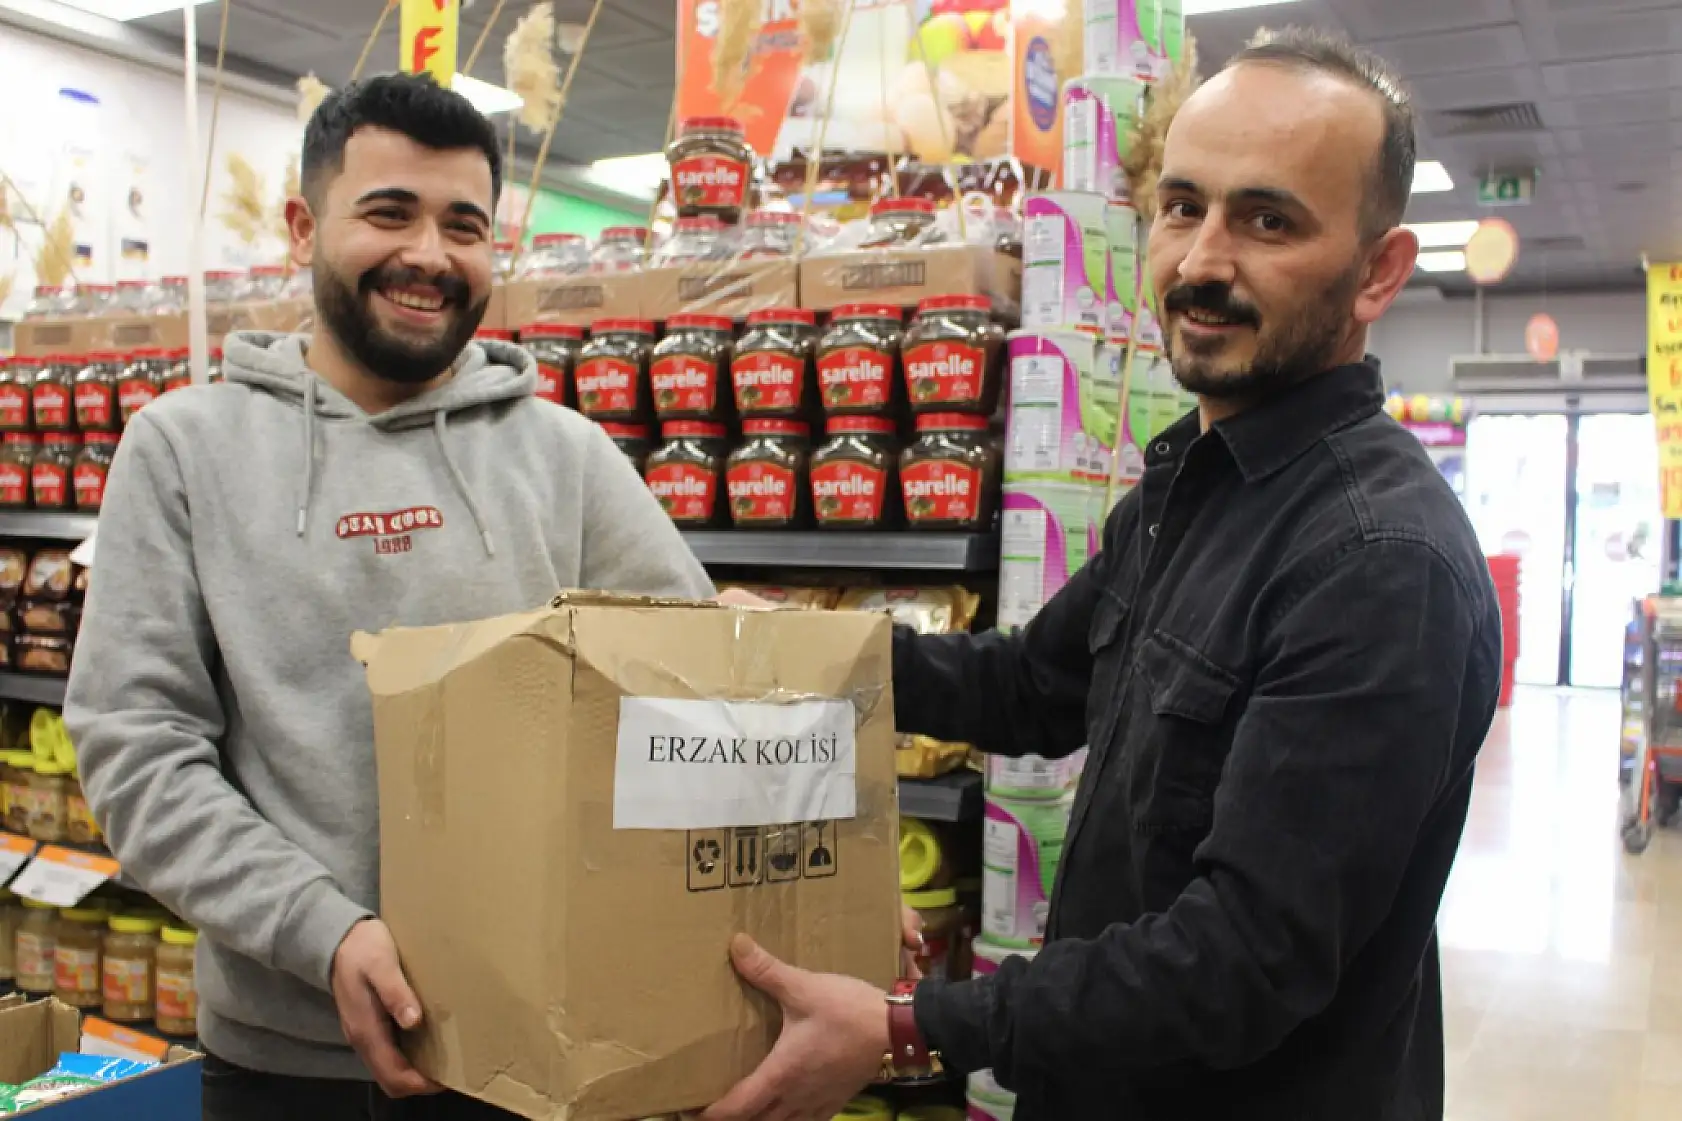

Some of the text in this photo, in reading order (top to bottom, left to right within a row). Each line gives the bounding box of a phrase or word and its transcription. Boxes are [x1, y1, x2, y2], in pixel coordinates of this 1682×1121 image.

[734, 364, 794, 386] sarelle
[821, 359, 884, 385] sarelle
[908, 354, 974, 379] sarelle
[576, 369, 629, 391] sarelle
[653, 368, 707, 390] sarelle
[728, 474, 786, 496] sarelle
[813, 474, 874, 496] sarelle
[903, 474, 969, 496] sarelle
[648, 732, 838, 765] ERZAK KOLİSİ
